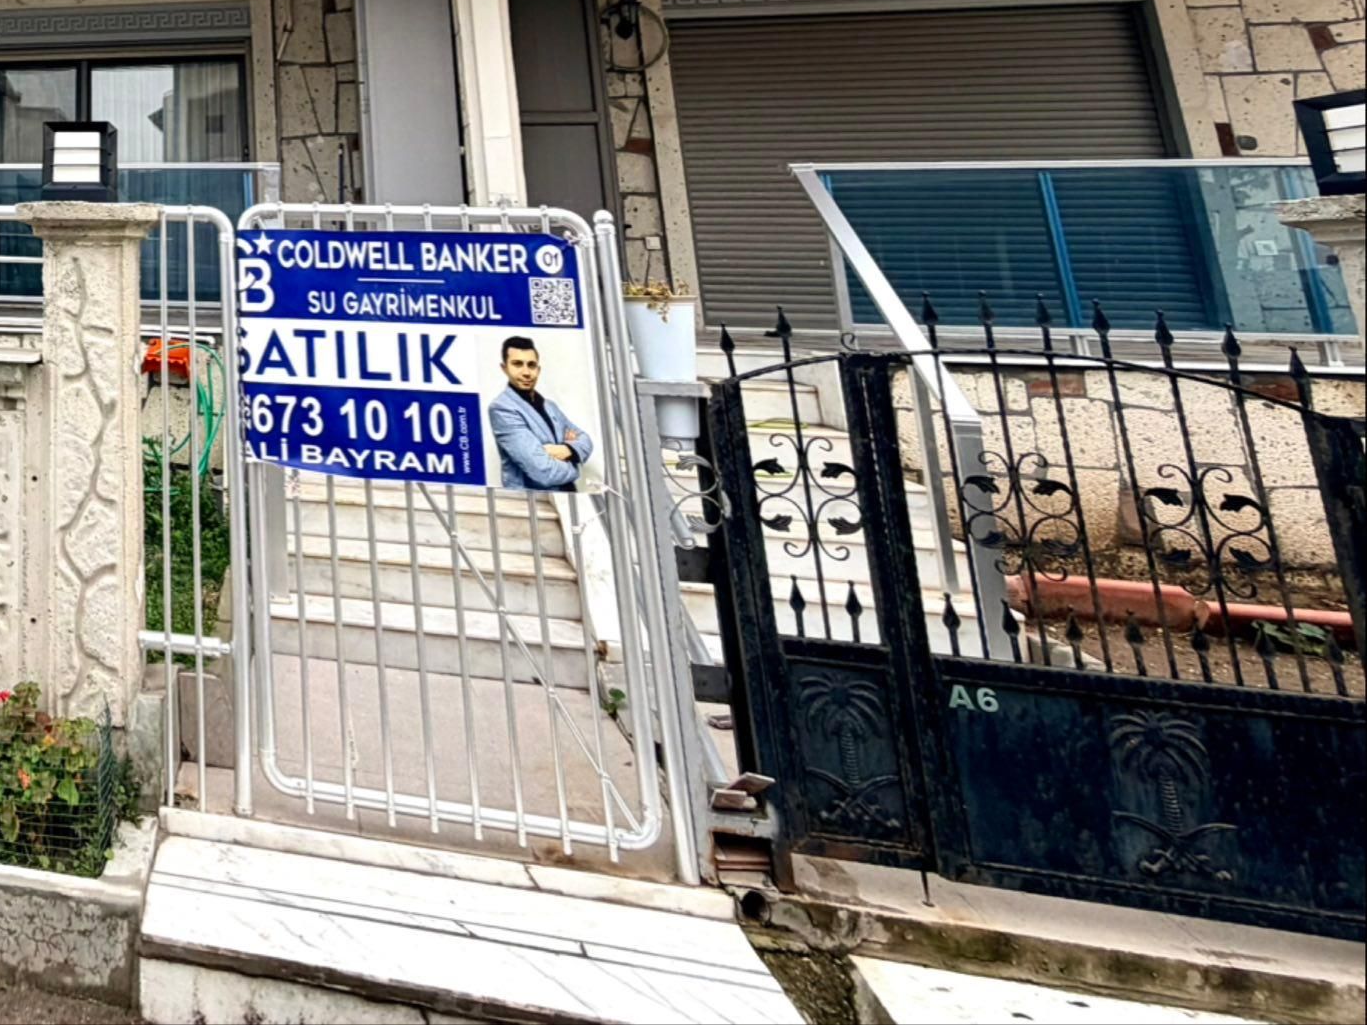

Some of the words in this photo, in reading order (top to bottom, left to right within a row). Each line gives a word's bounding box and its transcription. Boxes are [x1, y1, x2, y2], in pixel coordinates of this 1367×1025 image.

[277, 239, 414, 271] COLDWELL
[421, 242, 530, 274] BANKER
[307, 290, 335, 315] SU
[342, 287, 502, 320] GAYRİMENKUL
[339, 397, 388, 442] 10
[403, 401, 454, 445] 10
[300, 444, 456, 475] BAYRAM
[948, 683, 1000, 713] A6
